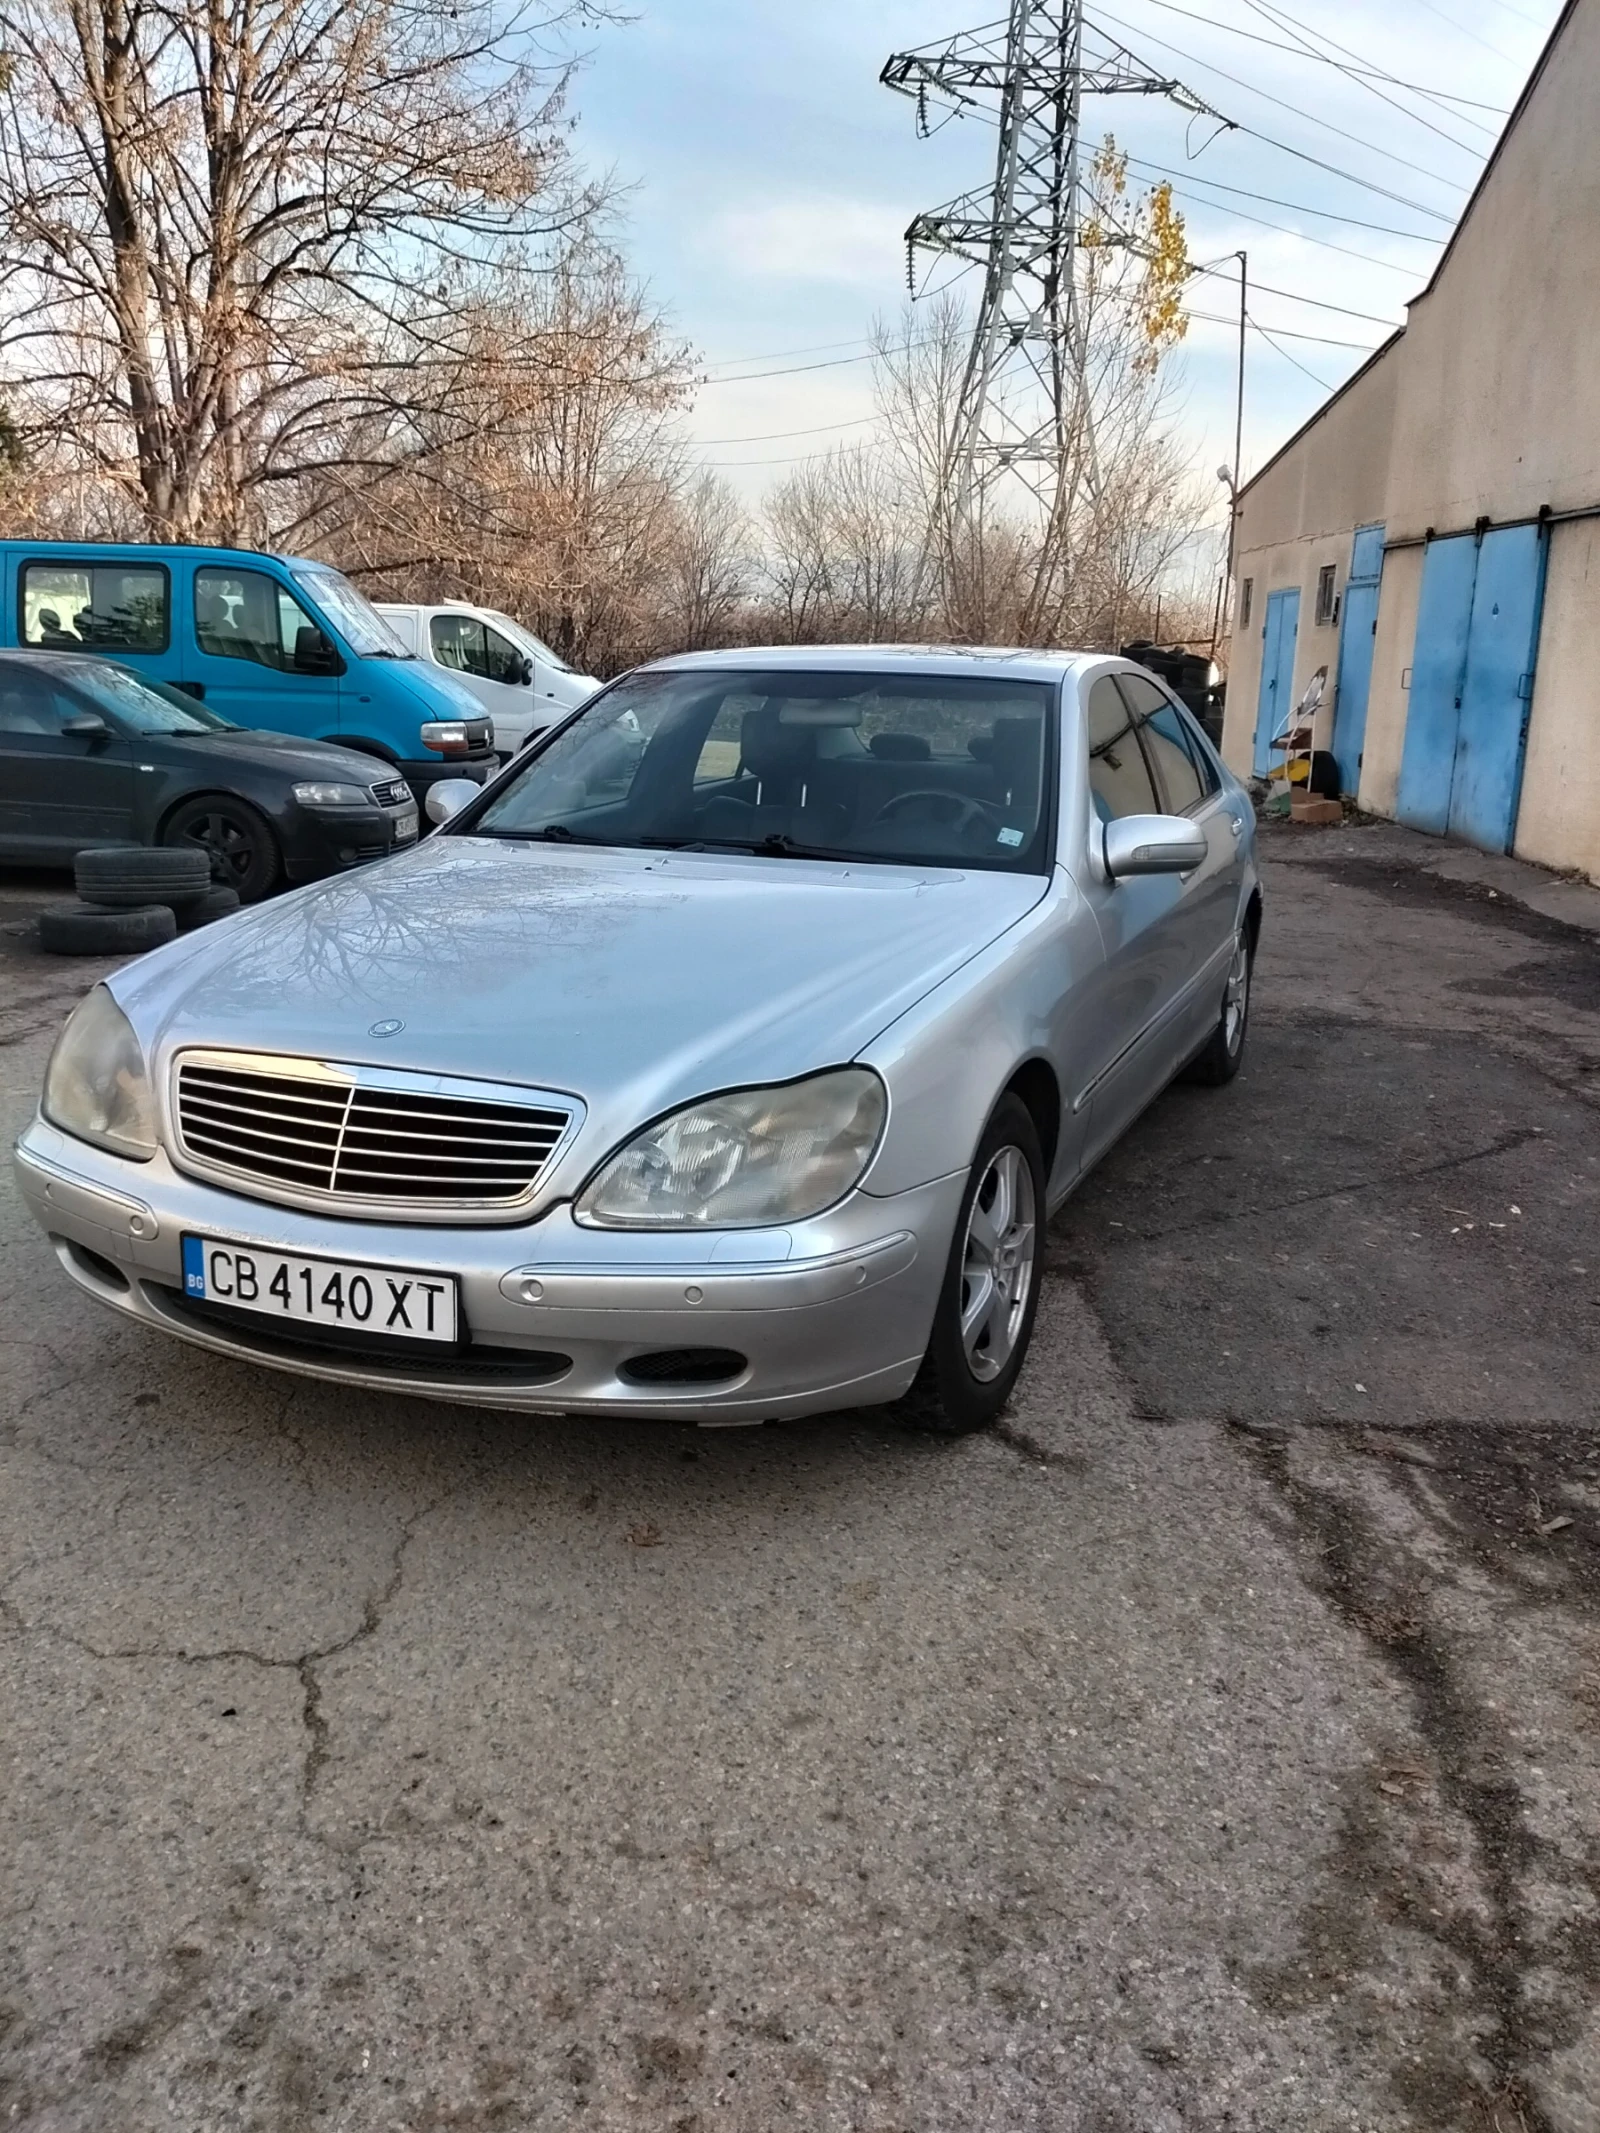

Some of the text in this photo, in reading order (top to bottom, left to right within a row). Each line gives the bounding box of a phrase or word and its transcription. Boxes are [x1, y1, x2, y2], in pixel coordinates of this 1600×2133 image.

[187, 1273, 204, 1289] BG
[209, 1249, 445, 1332] CB 4140 XT
